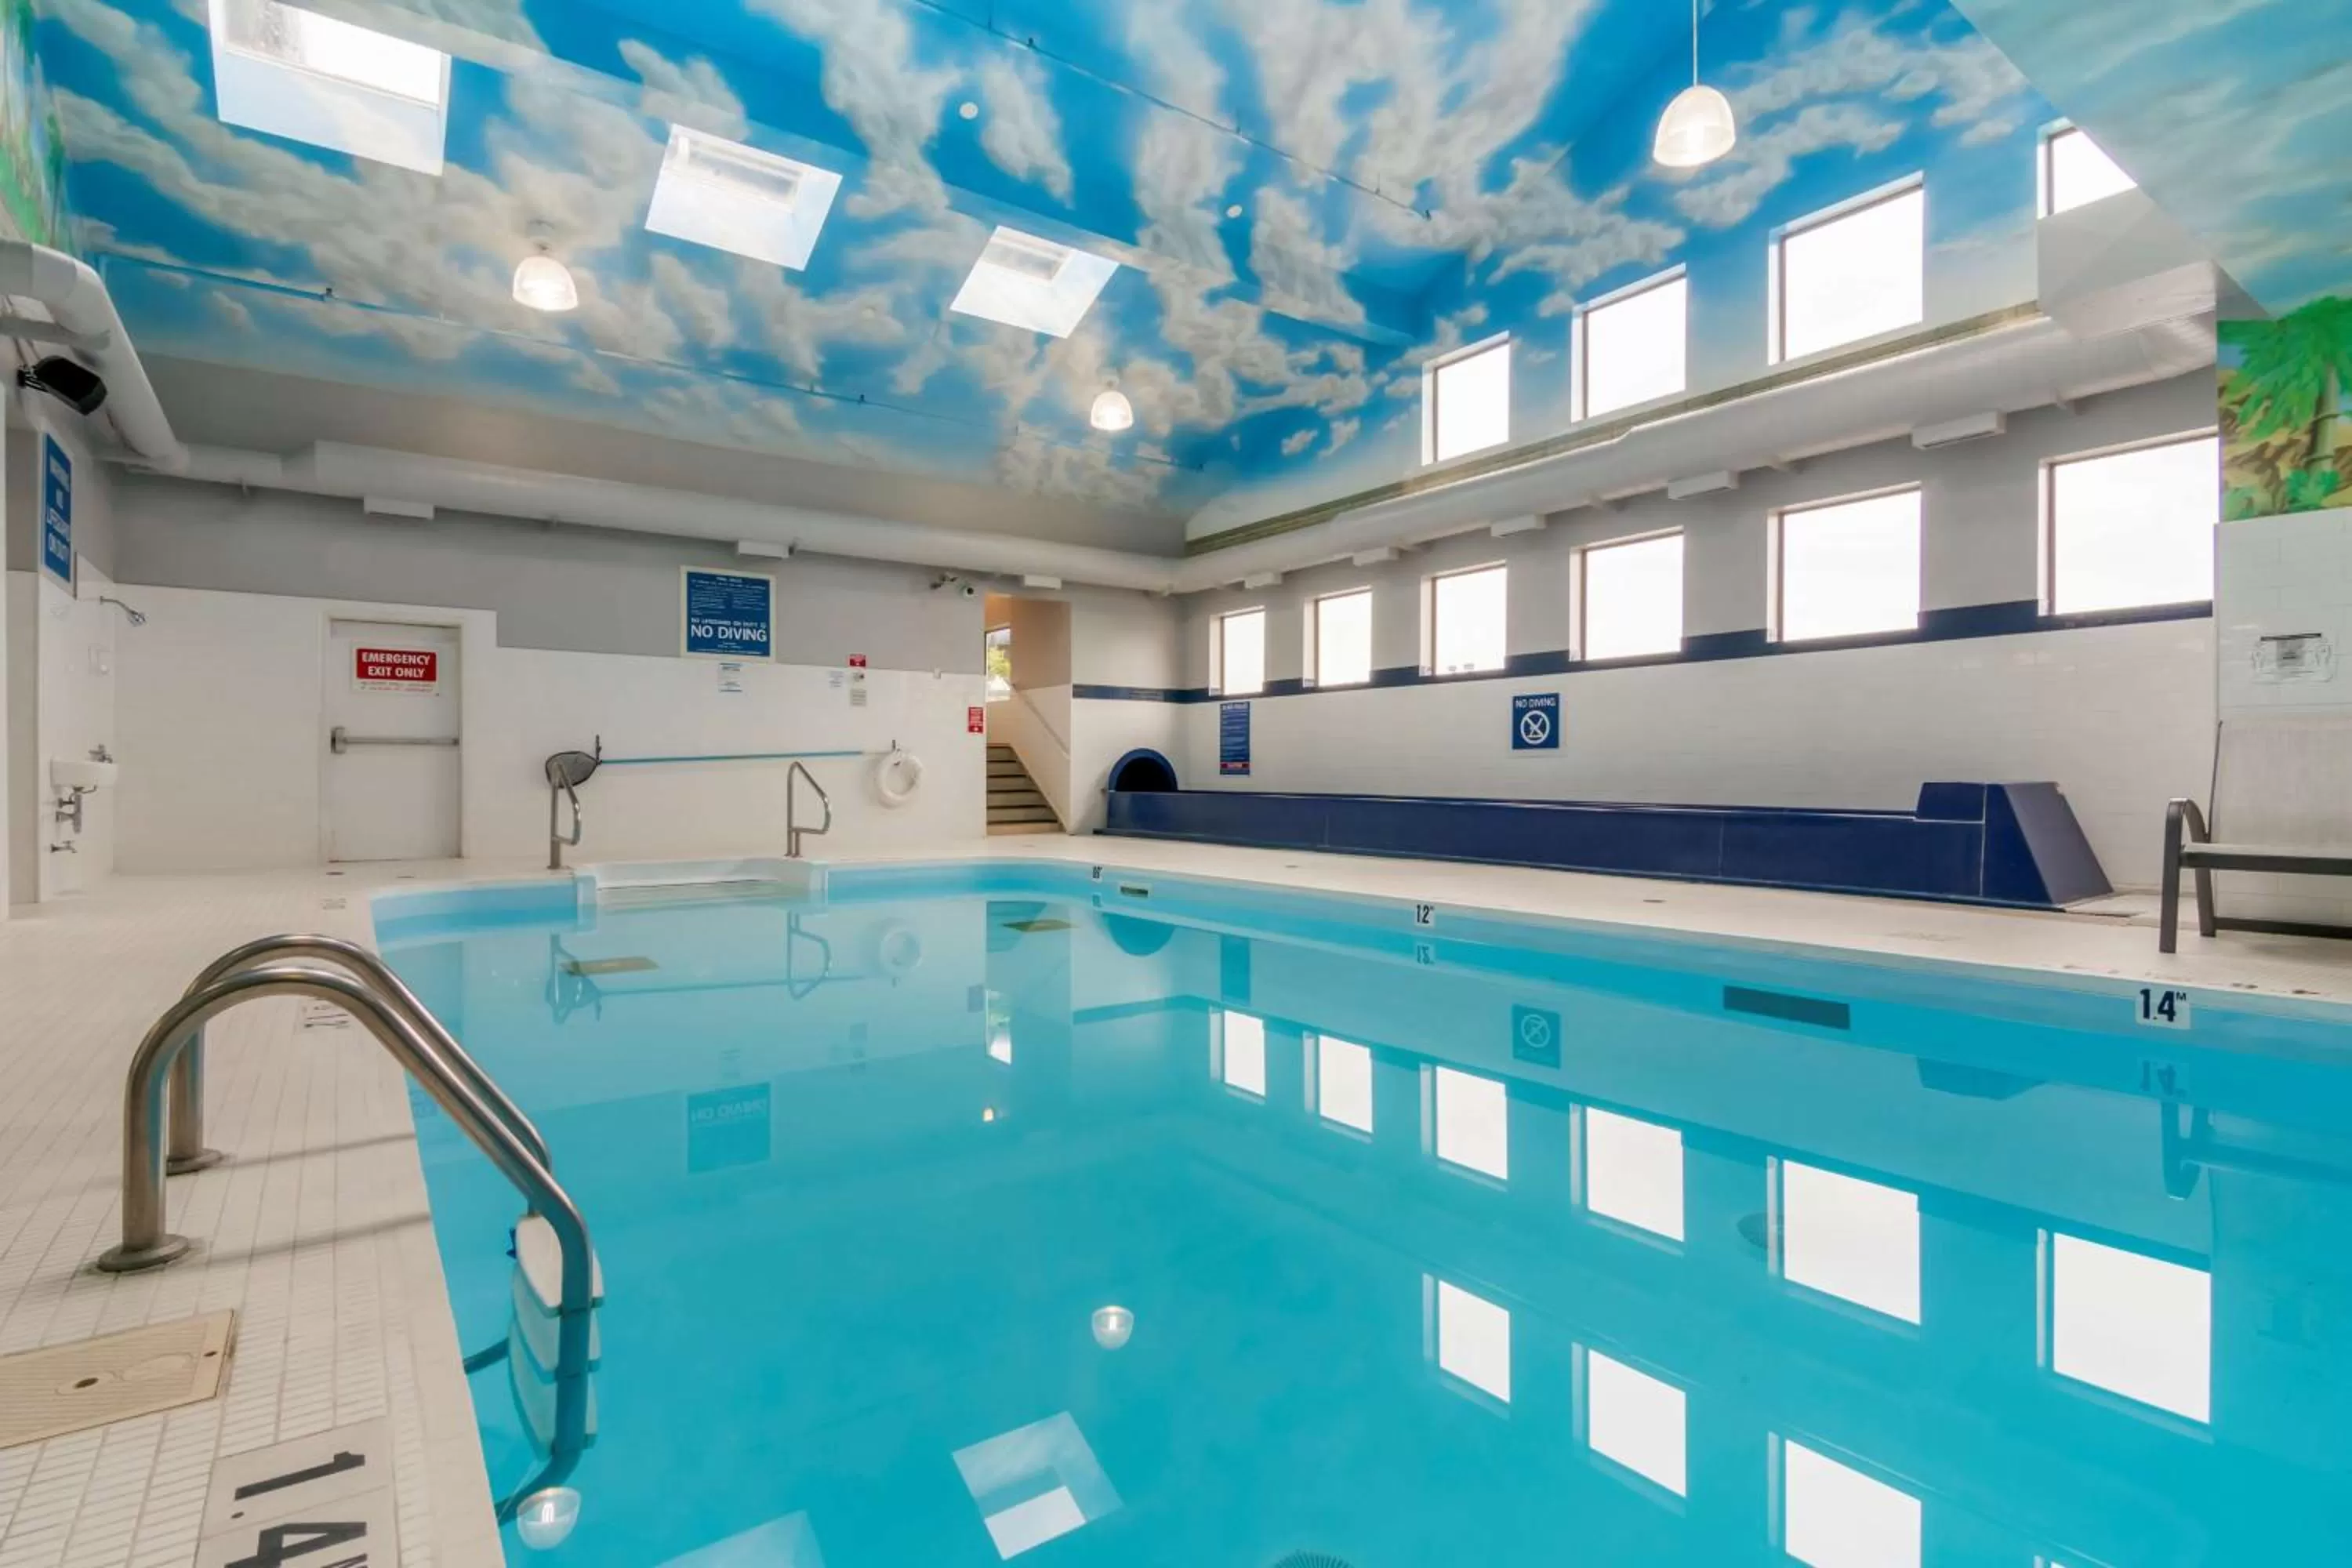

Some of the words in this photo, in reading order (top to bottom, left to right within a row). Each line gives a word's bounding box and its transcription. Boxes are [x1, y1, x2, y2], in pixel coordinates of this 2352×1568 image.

[691, 625, 713, 638] NO
[717, 626, 768, 642] DIVING
[361, 652, 431, 666] EMERGENCY
[368, 666, 393, 677] EXIT
[394, 667, 426, 678] ONLY
[1515, 698, 1527, 709] NO
[1528, 696, 1557, 709] DIVING
